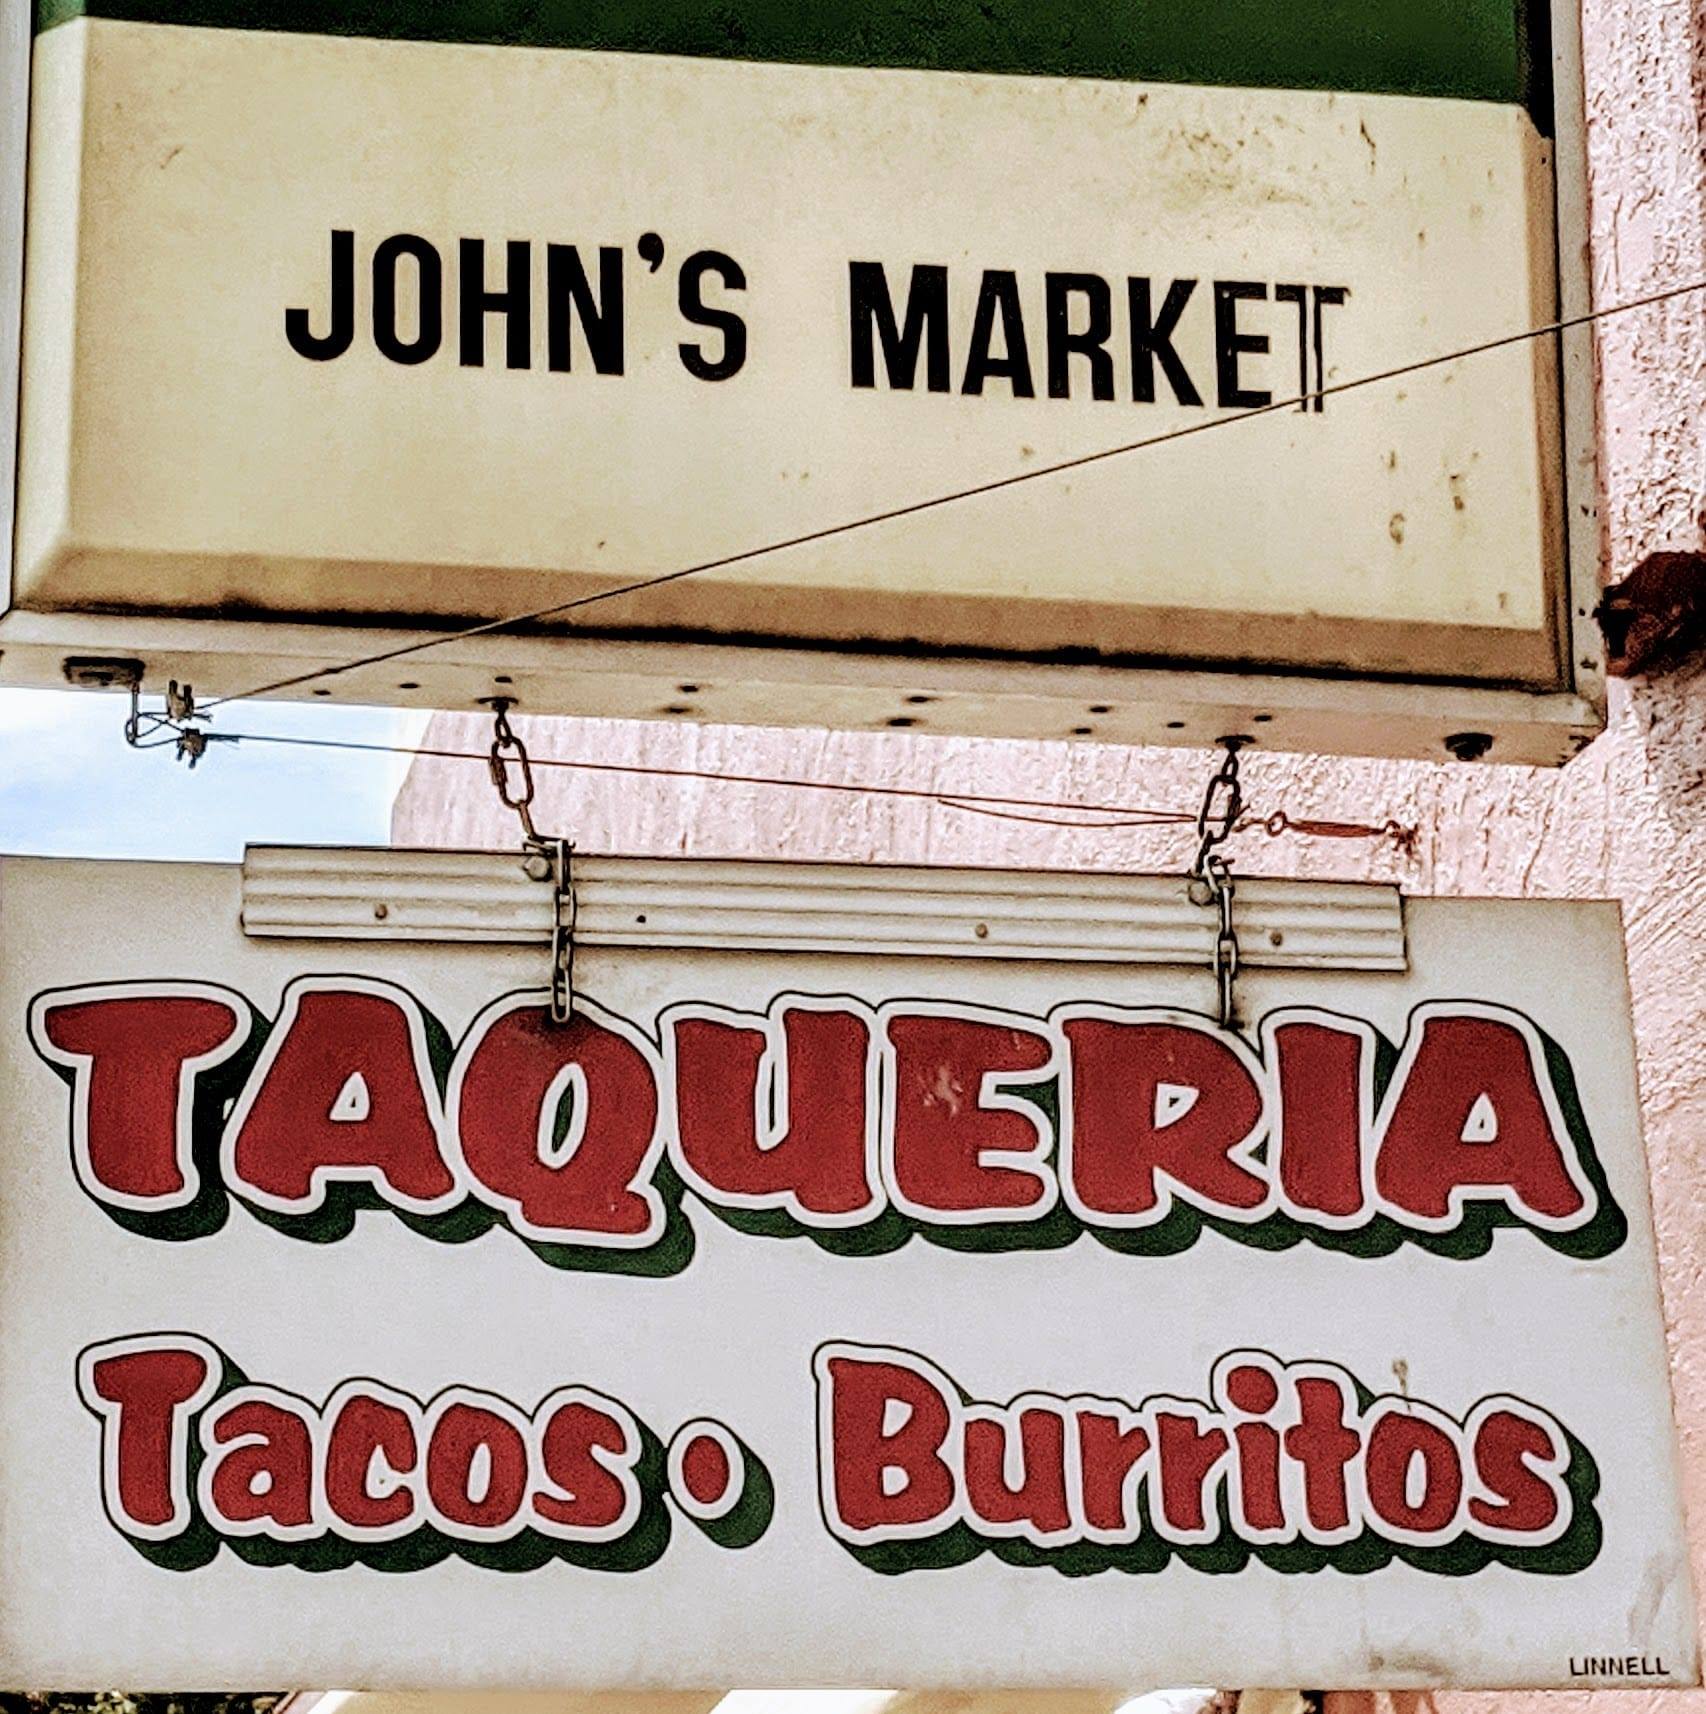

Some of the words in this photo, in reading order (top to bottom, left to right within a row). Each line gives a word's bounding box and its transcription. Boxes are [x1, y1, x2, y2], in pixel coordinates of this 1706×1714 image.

[285, 229, 748, 383] JOHN'S
[848, 259, 1351, 413] MARKET
[28, 975, 1610, 1255] TAQUERIA
[78, 1333, 650, 1552] Tacos
[813, 1342, 1585, 1558] Burritos
[1569, 1656, 1671, 1677] LINNELL
